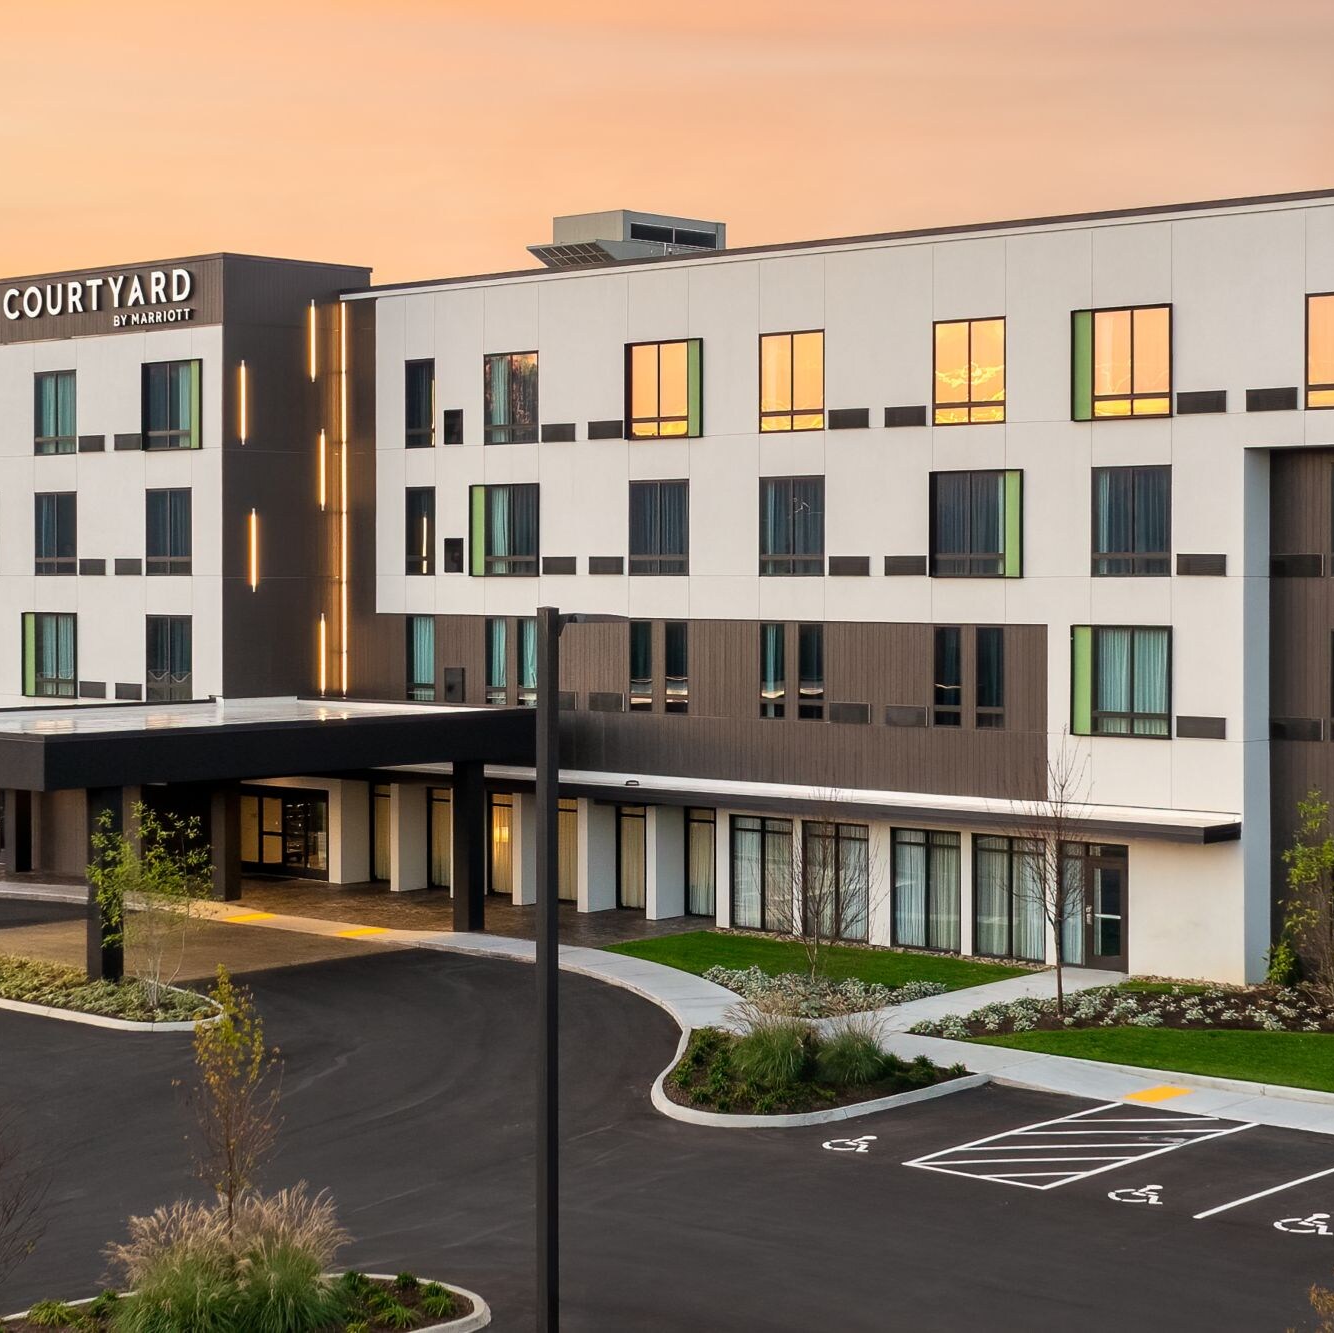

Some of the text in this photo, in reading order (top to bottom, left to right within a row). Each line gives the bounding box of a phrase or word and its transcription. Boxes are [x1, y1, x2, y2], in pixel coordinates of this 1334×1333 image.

[3, 268, 191, 320] COURTYARD
[113, 308, 191, 327] BY MARRIOTT
